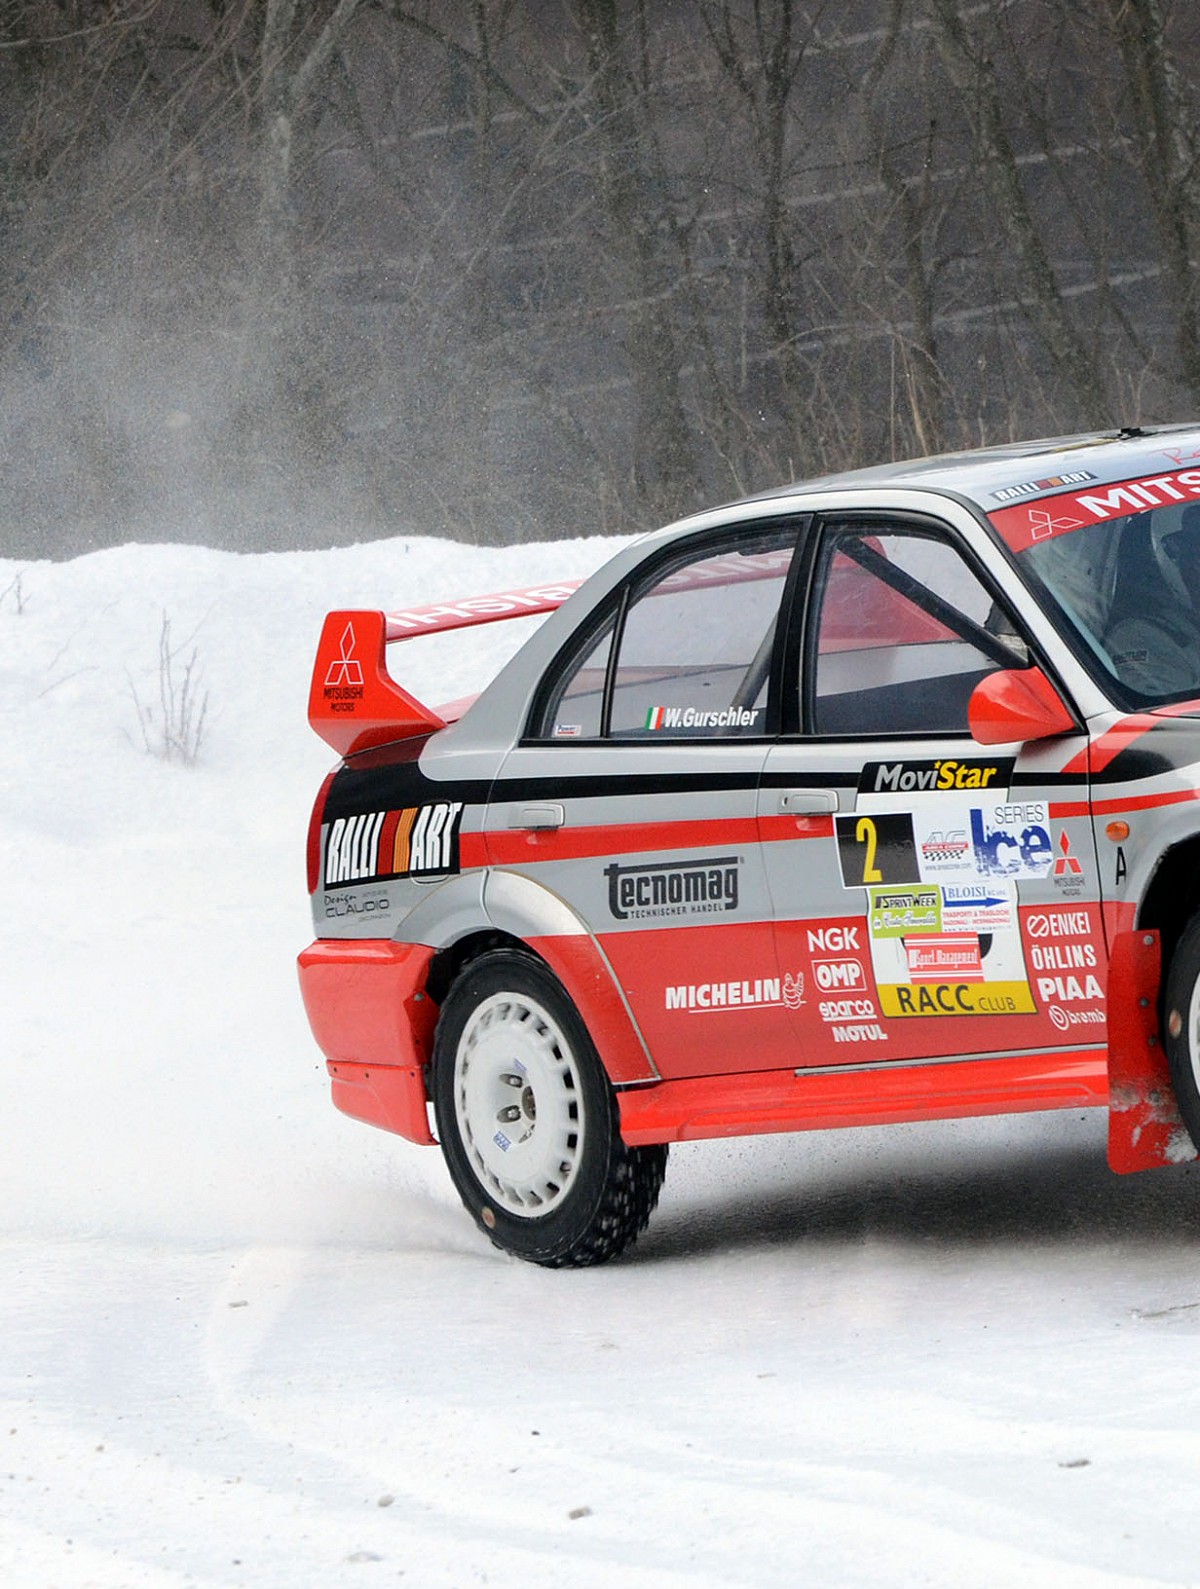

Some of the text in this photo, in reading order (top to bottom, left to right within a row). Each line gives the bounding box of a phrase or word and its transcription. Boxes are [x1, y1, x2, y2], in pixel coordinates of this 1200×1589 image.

[995, 471, 1092, 501] RALLI ART
[324, 687, 364, 700] MITSUBISHI
[664, 706, 760, 729] W.Gurschler
[874, 760, 998, 792] MoviStar
[994, 804, 1045, 825] SERIES
[326, 802, 464, 884] RALLI ART
[855, 817, 883, 883] 2
[604, 856, 739, 919] tecnomag
[948, 886, 987, 898] BLOISI
[326, 898, 390, 918] CLAUDIO
[630, 902, 723, 919] TECHNISCHER HANDEL
[1050, 912, 1092, 937] ENKEI
[807, 927, 861, 953] NGK
[1031, 944, 1098, 971] ÖHLINS
[816, 962, 861, 989] OMP
[1037, 974, 1105, 1002] PIAA
[665, 978, 781, 1010] MICHELIN
[896, 985, 1017, 1013] RACC CLUB
[819, 999, 875, 1018] sparco
[832, 1023, 888, 1043] MOTUL
